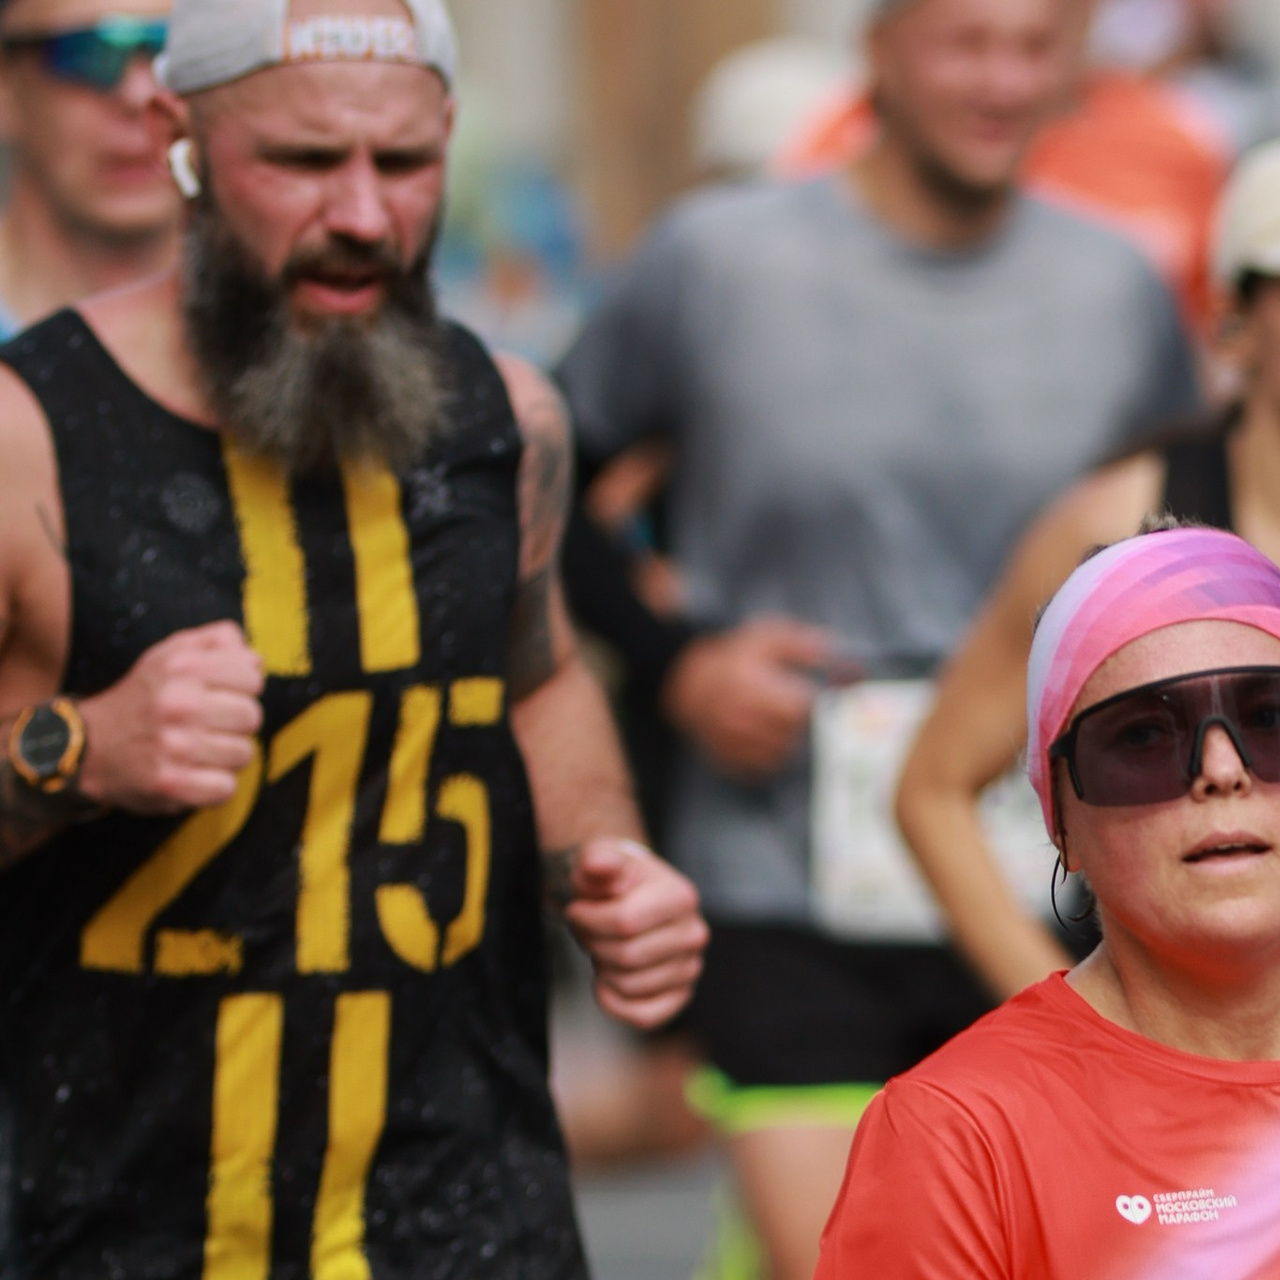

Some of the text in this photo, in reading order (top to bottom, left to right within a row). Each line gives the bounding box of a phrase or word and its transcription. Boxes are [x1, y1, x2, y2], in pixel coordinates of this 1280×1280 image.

[1153, 1187, 1215, 1203] СБЕРПРАЙМ
[1155, 1195, 1237, 1214] МОСКОВСКИЙ
[1158, 1210, 1219, 1225] МАРАФОН
